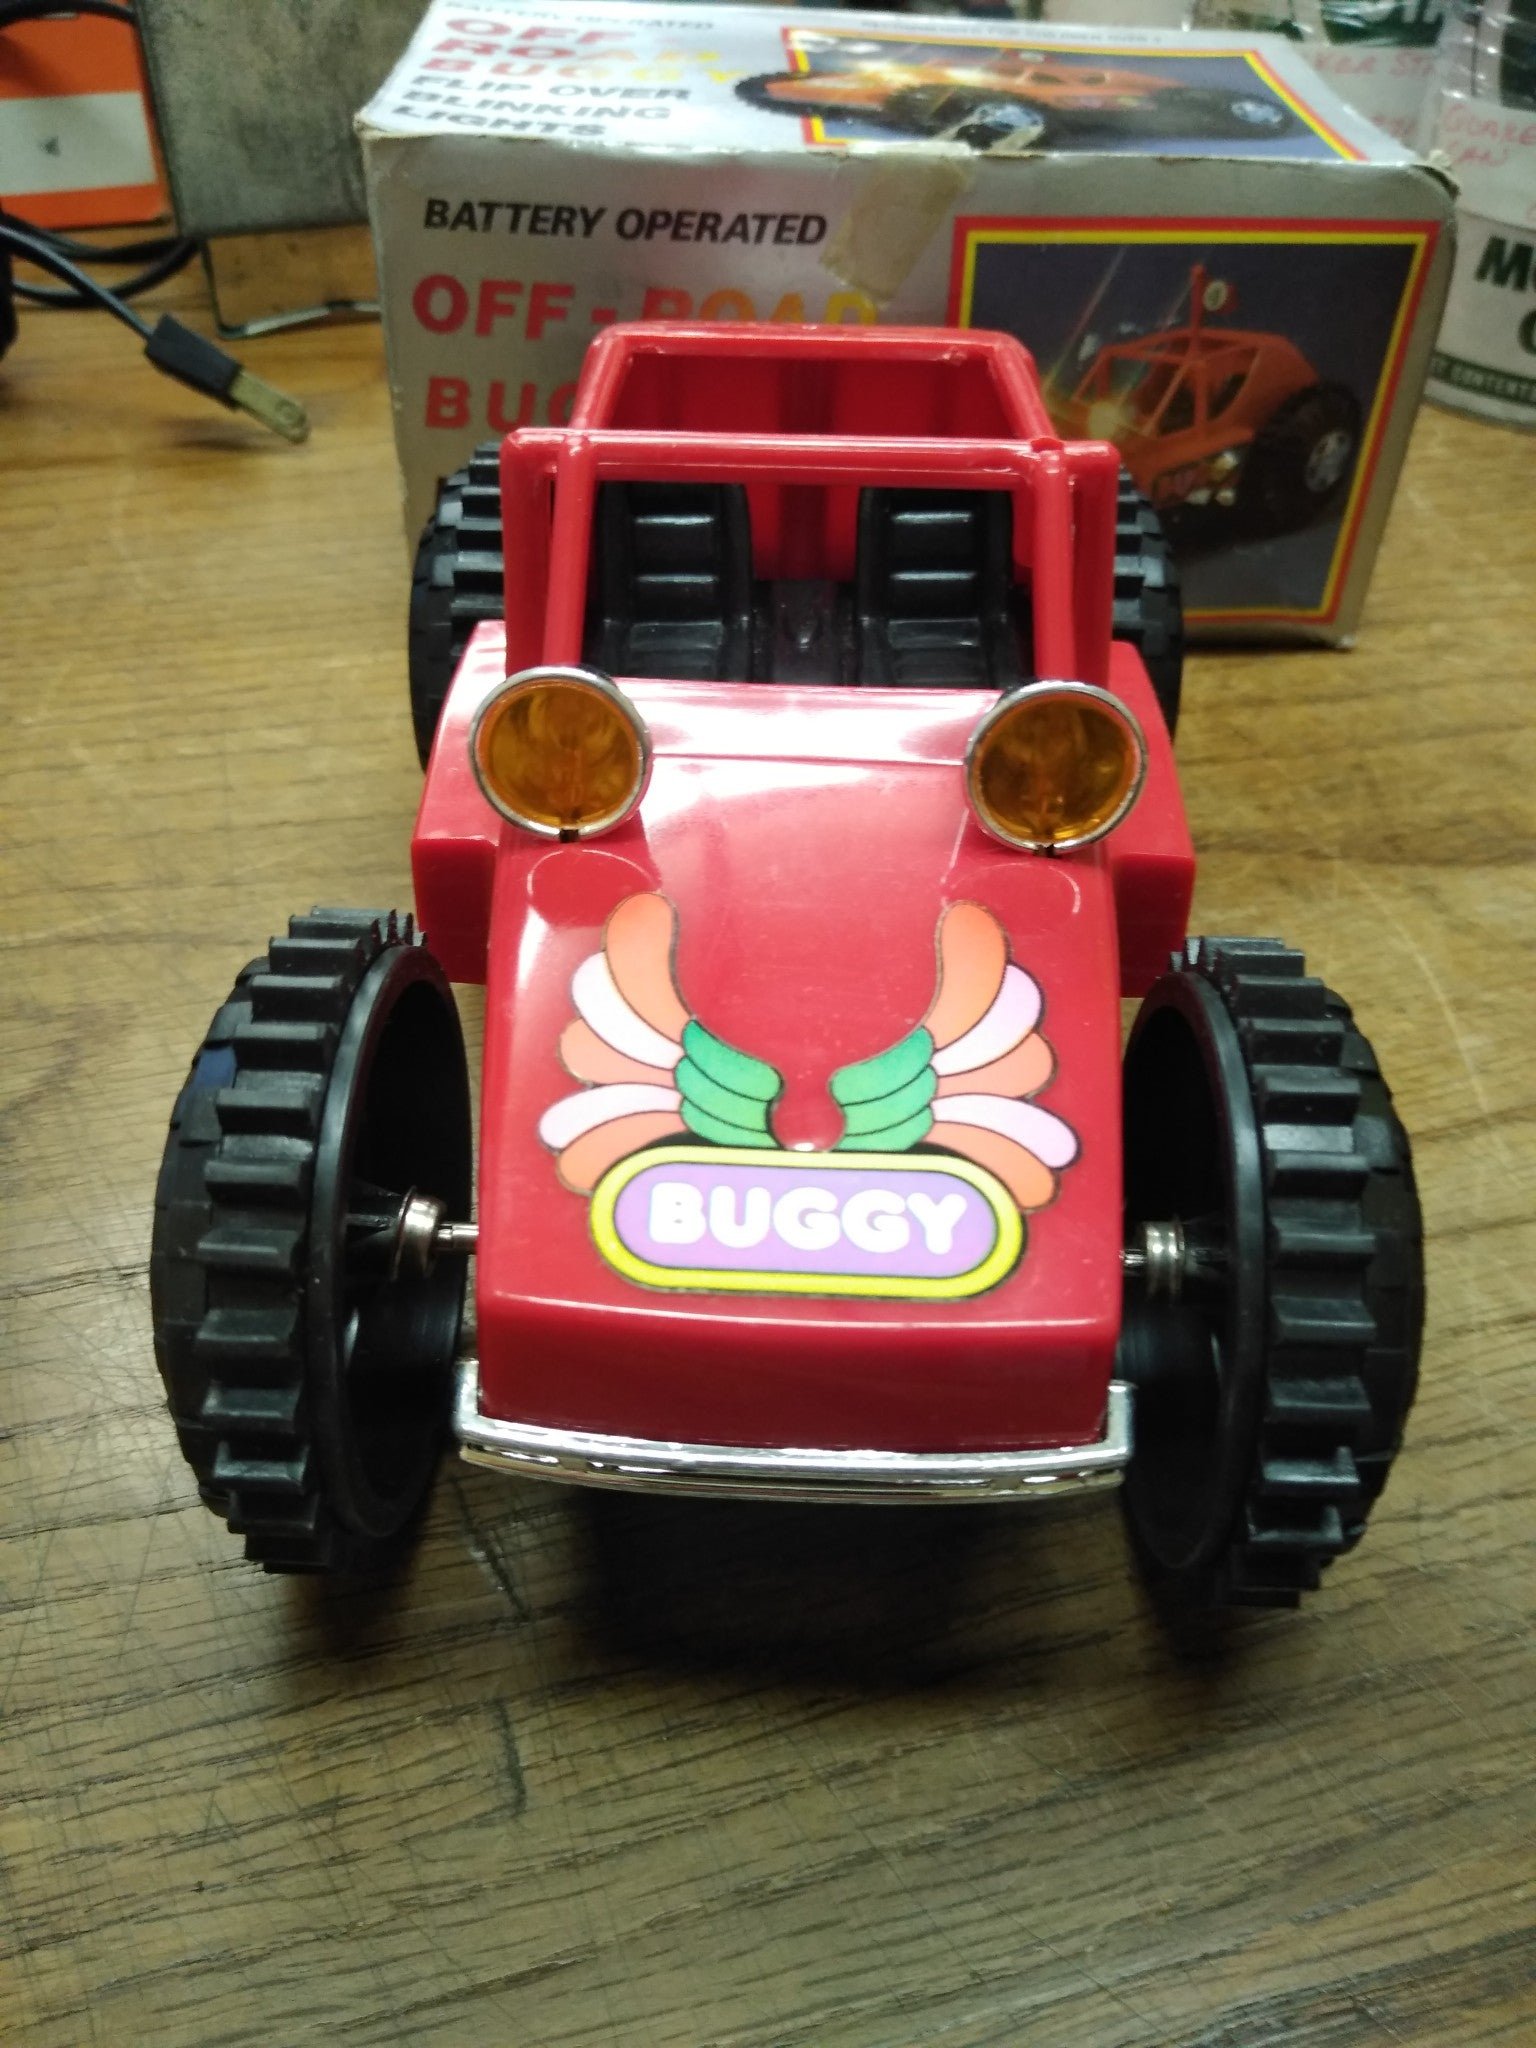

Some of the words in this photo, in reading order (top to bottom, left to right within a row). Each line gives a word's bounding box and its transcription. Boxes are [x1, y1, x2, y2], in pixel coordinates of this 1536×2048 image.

[445, 18, 636, 44] OFF
[420, 57, 750, 84] BUGGY
[410, 75, 532, 93] FLIP
[549, 83, 692, 101] OVER
[402, 90, 672, 120] BLINKING
[392, 105, 607, 136] LIGHTS
[423, 197, 606, 240] BATTERY
[616, 207, 828, 246] OPERATED
[648, 1181, 968, 1255] BUGGY
